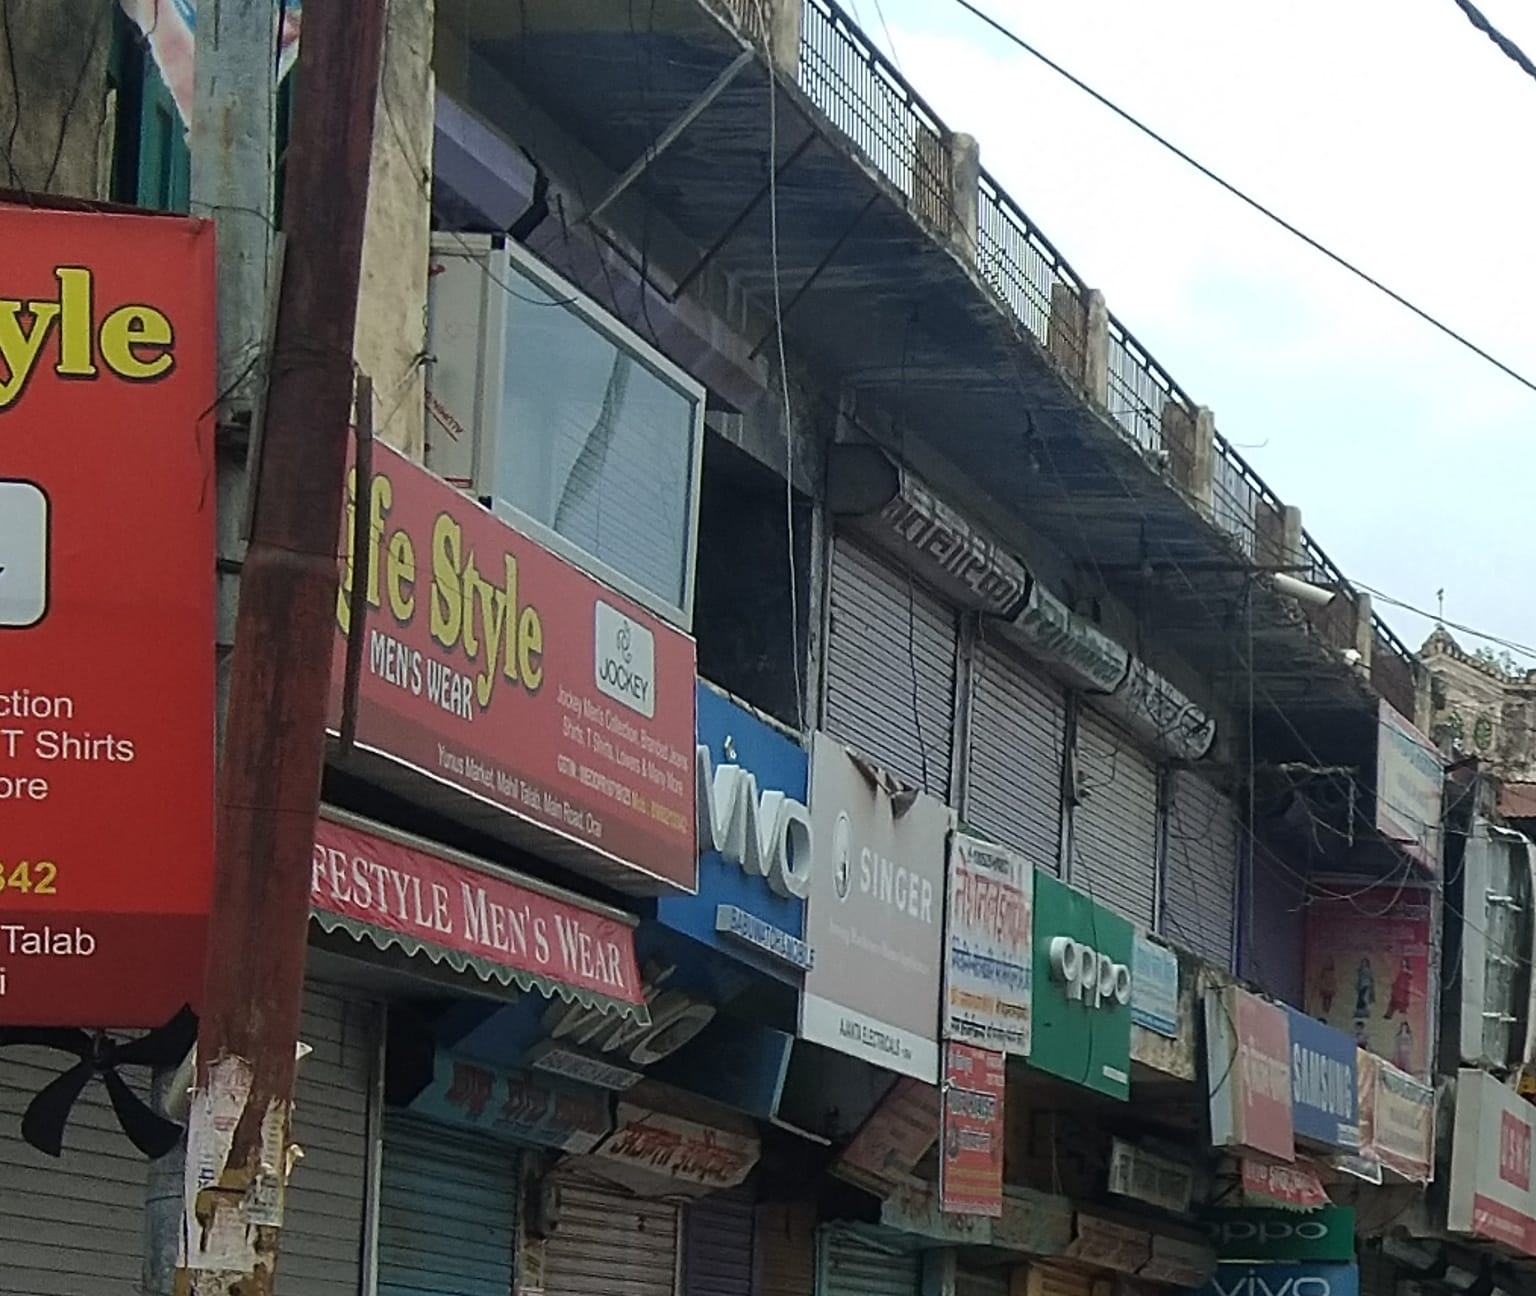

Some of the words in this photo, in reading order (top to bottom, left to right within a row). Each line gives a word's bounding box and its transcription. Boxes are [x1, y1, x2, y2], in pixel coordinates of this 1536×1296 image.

[430, 512, 543, 707] Style
[370, 630, 423, 695] MEN'S
[427, 658, 474, 721] WEAR
[600, 660, 649, 702] JOCKEY
[1, 729, 23, 758] T
[35, 730, 134, 762] Shirts
[697, 736, 813, 899] vivo
[860, 847, 933, 924] SINGER
[0, 926, 95, 956] Talab
[554, 915, 625, 988] WEAR
[1050, 936, 1131, 1009] oppo
[1293, 1043, 1351, 1119] SAMSUNG
